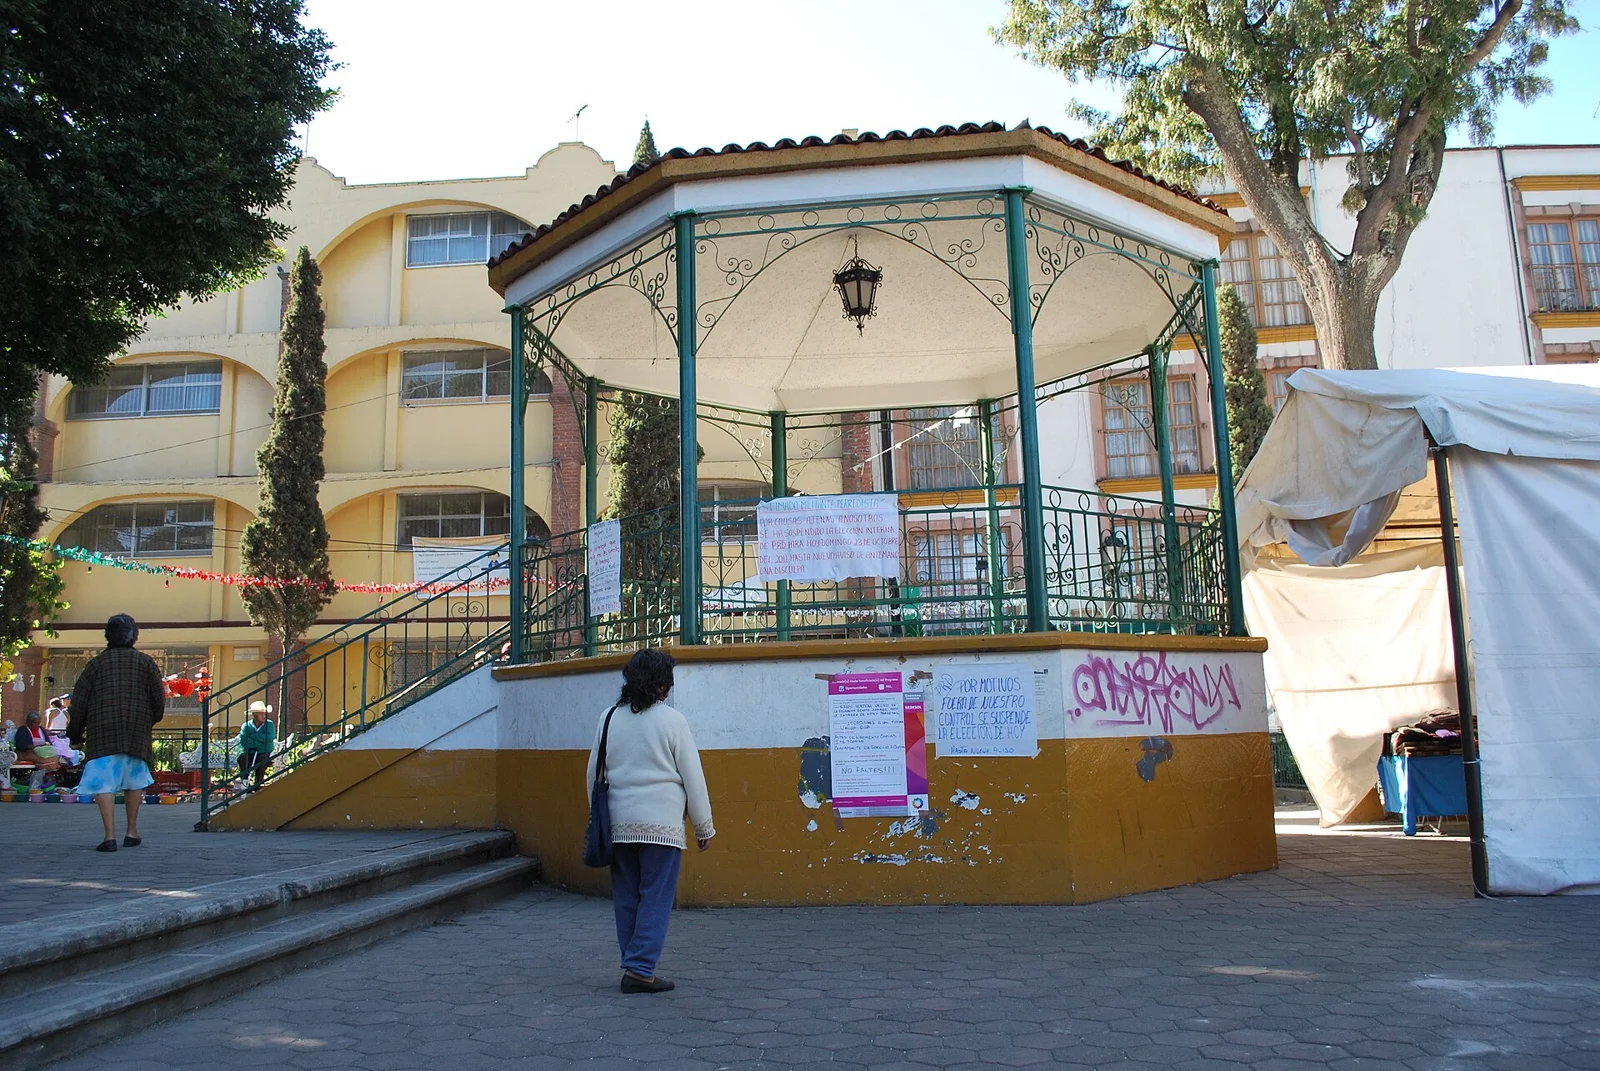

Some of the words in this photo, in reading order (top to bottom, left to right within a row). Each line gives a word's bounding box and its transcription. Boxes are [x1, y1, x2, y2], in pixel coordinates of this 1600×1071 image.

[760, 517, 772, 527] POR
[774, 516, 802, 526] CAUSAS
[806, 515, 834, 525] AJENAS
[760, 530, 769, 538] SE
[772, 530, 783, 538] HA
[784, 528, 824, 538] SUSPENDIDO
[866, 526, 896, 534] INTERNA
[760, 542, 768, 550] DE
[771, 540, 787, 550] PRD
[821, 538, 852, 546] DOMINGO
[760, 555, 772, 564] DEL
[790, 552, 810, 562] HASTA
[760, 566, 773, 575] UNA
[774, 564, 805, 574] DISCULPA
[960, 678, 978, 693] POR
[980, 676, 1021, 693] MOTIVOS
[940, 696, 967, 710] FUERA
[968, 696, 978, 710] DE
[980, 694, 1026, 710] NUESTRO
[938, 712, 976, 726] CONTROL
[978, 712, 989, 726] SE
[990, 710, 1032, 725] SUSPENDE
[938, 726, 949, 740] LA
[994, 725, 1004, 740] DE
[1007, 724, 1026, 740] HOY
